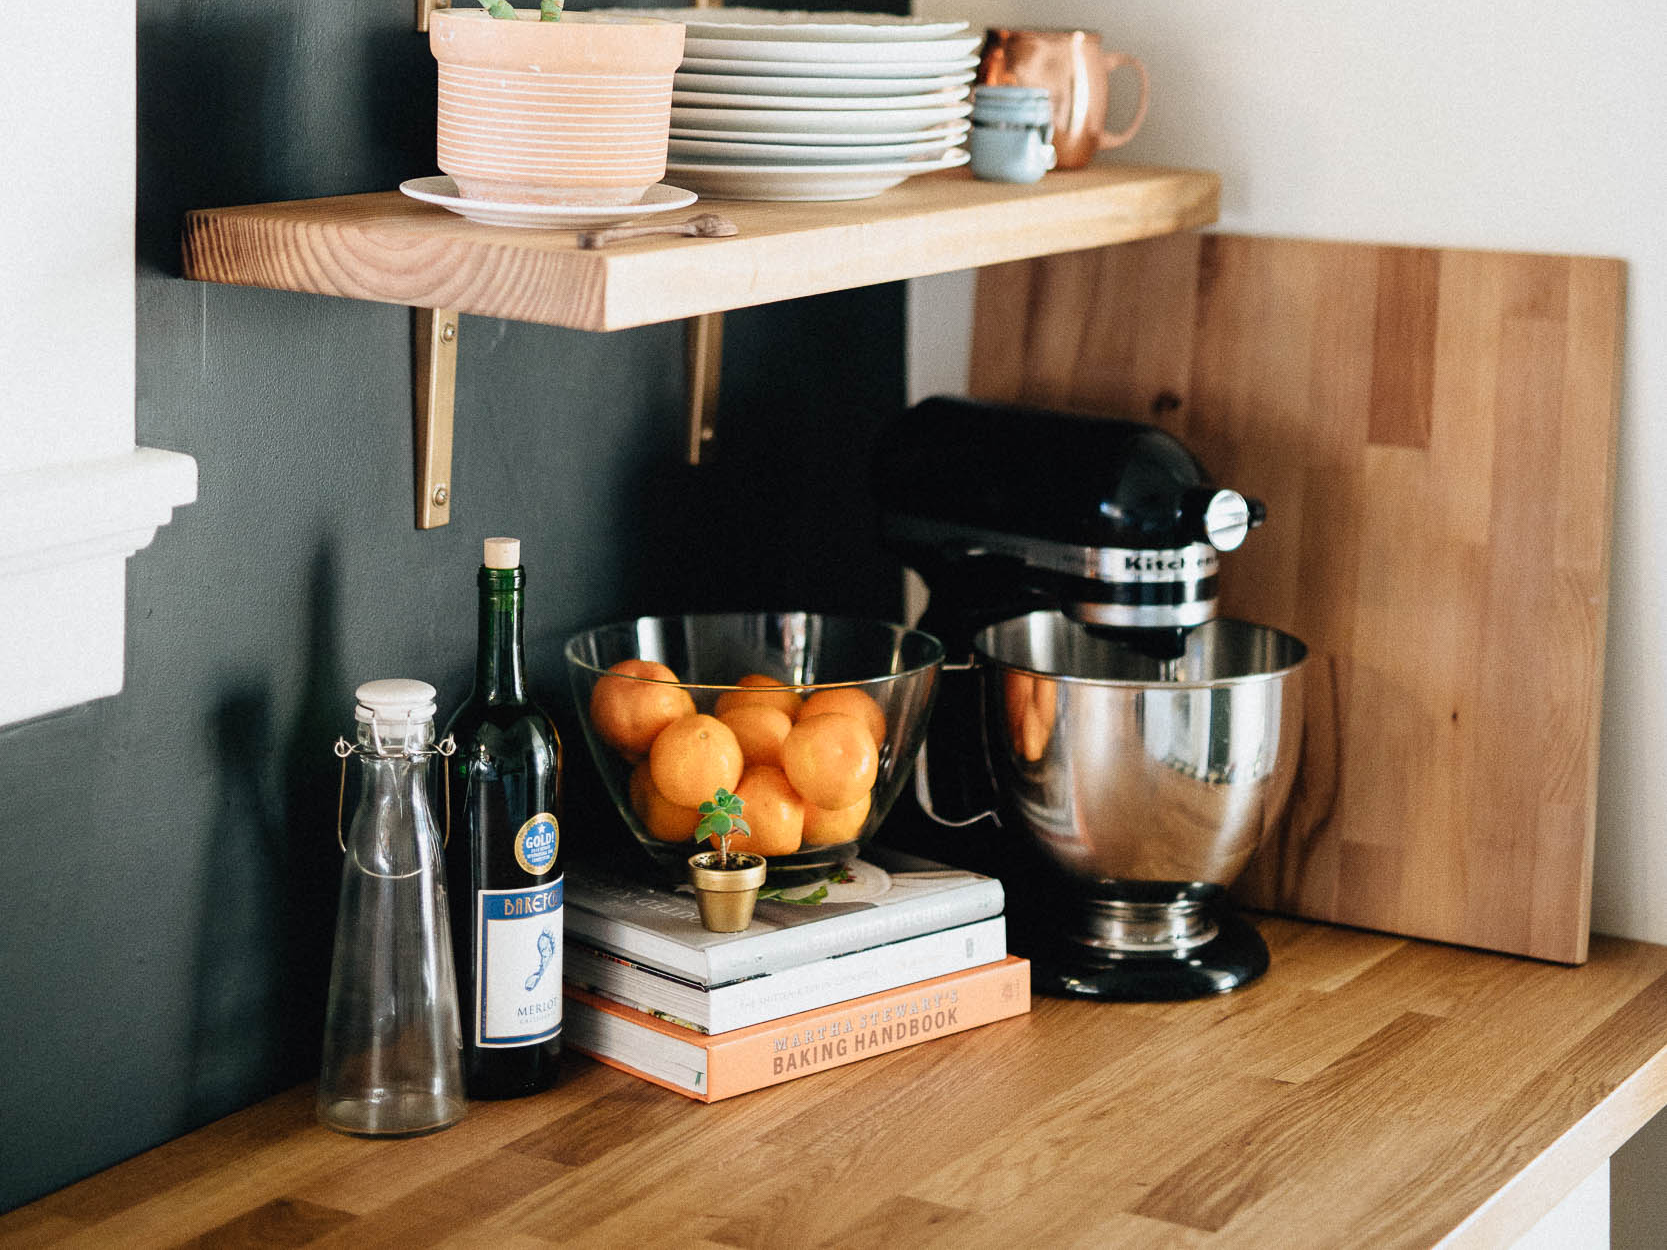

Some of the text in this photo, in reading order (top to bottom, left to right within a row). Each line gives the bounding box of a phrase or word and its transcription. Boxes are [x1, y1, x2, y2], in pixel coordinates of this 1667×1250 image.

[525, 831, 555, 849] GOLD!
[517, 996, 557, 1017] MERLOT
[772, 1018, 853, 1052] MARTHA
[773, 1007, 957, 1075] BAKING HANDBOOK
